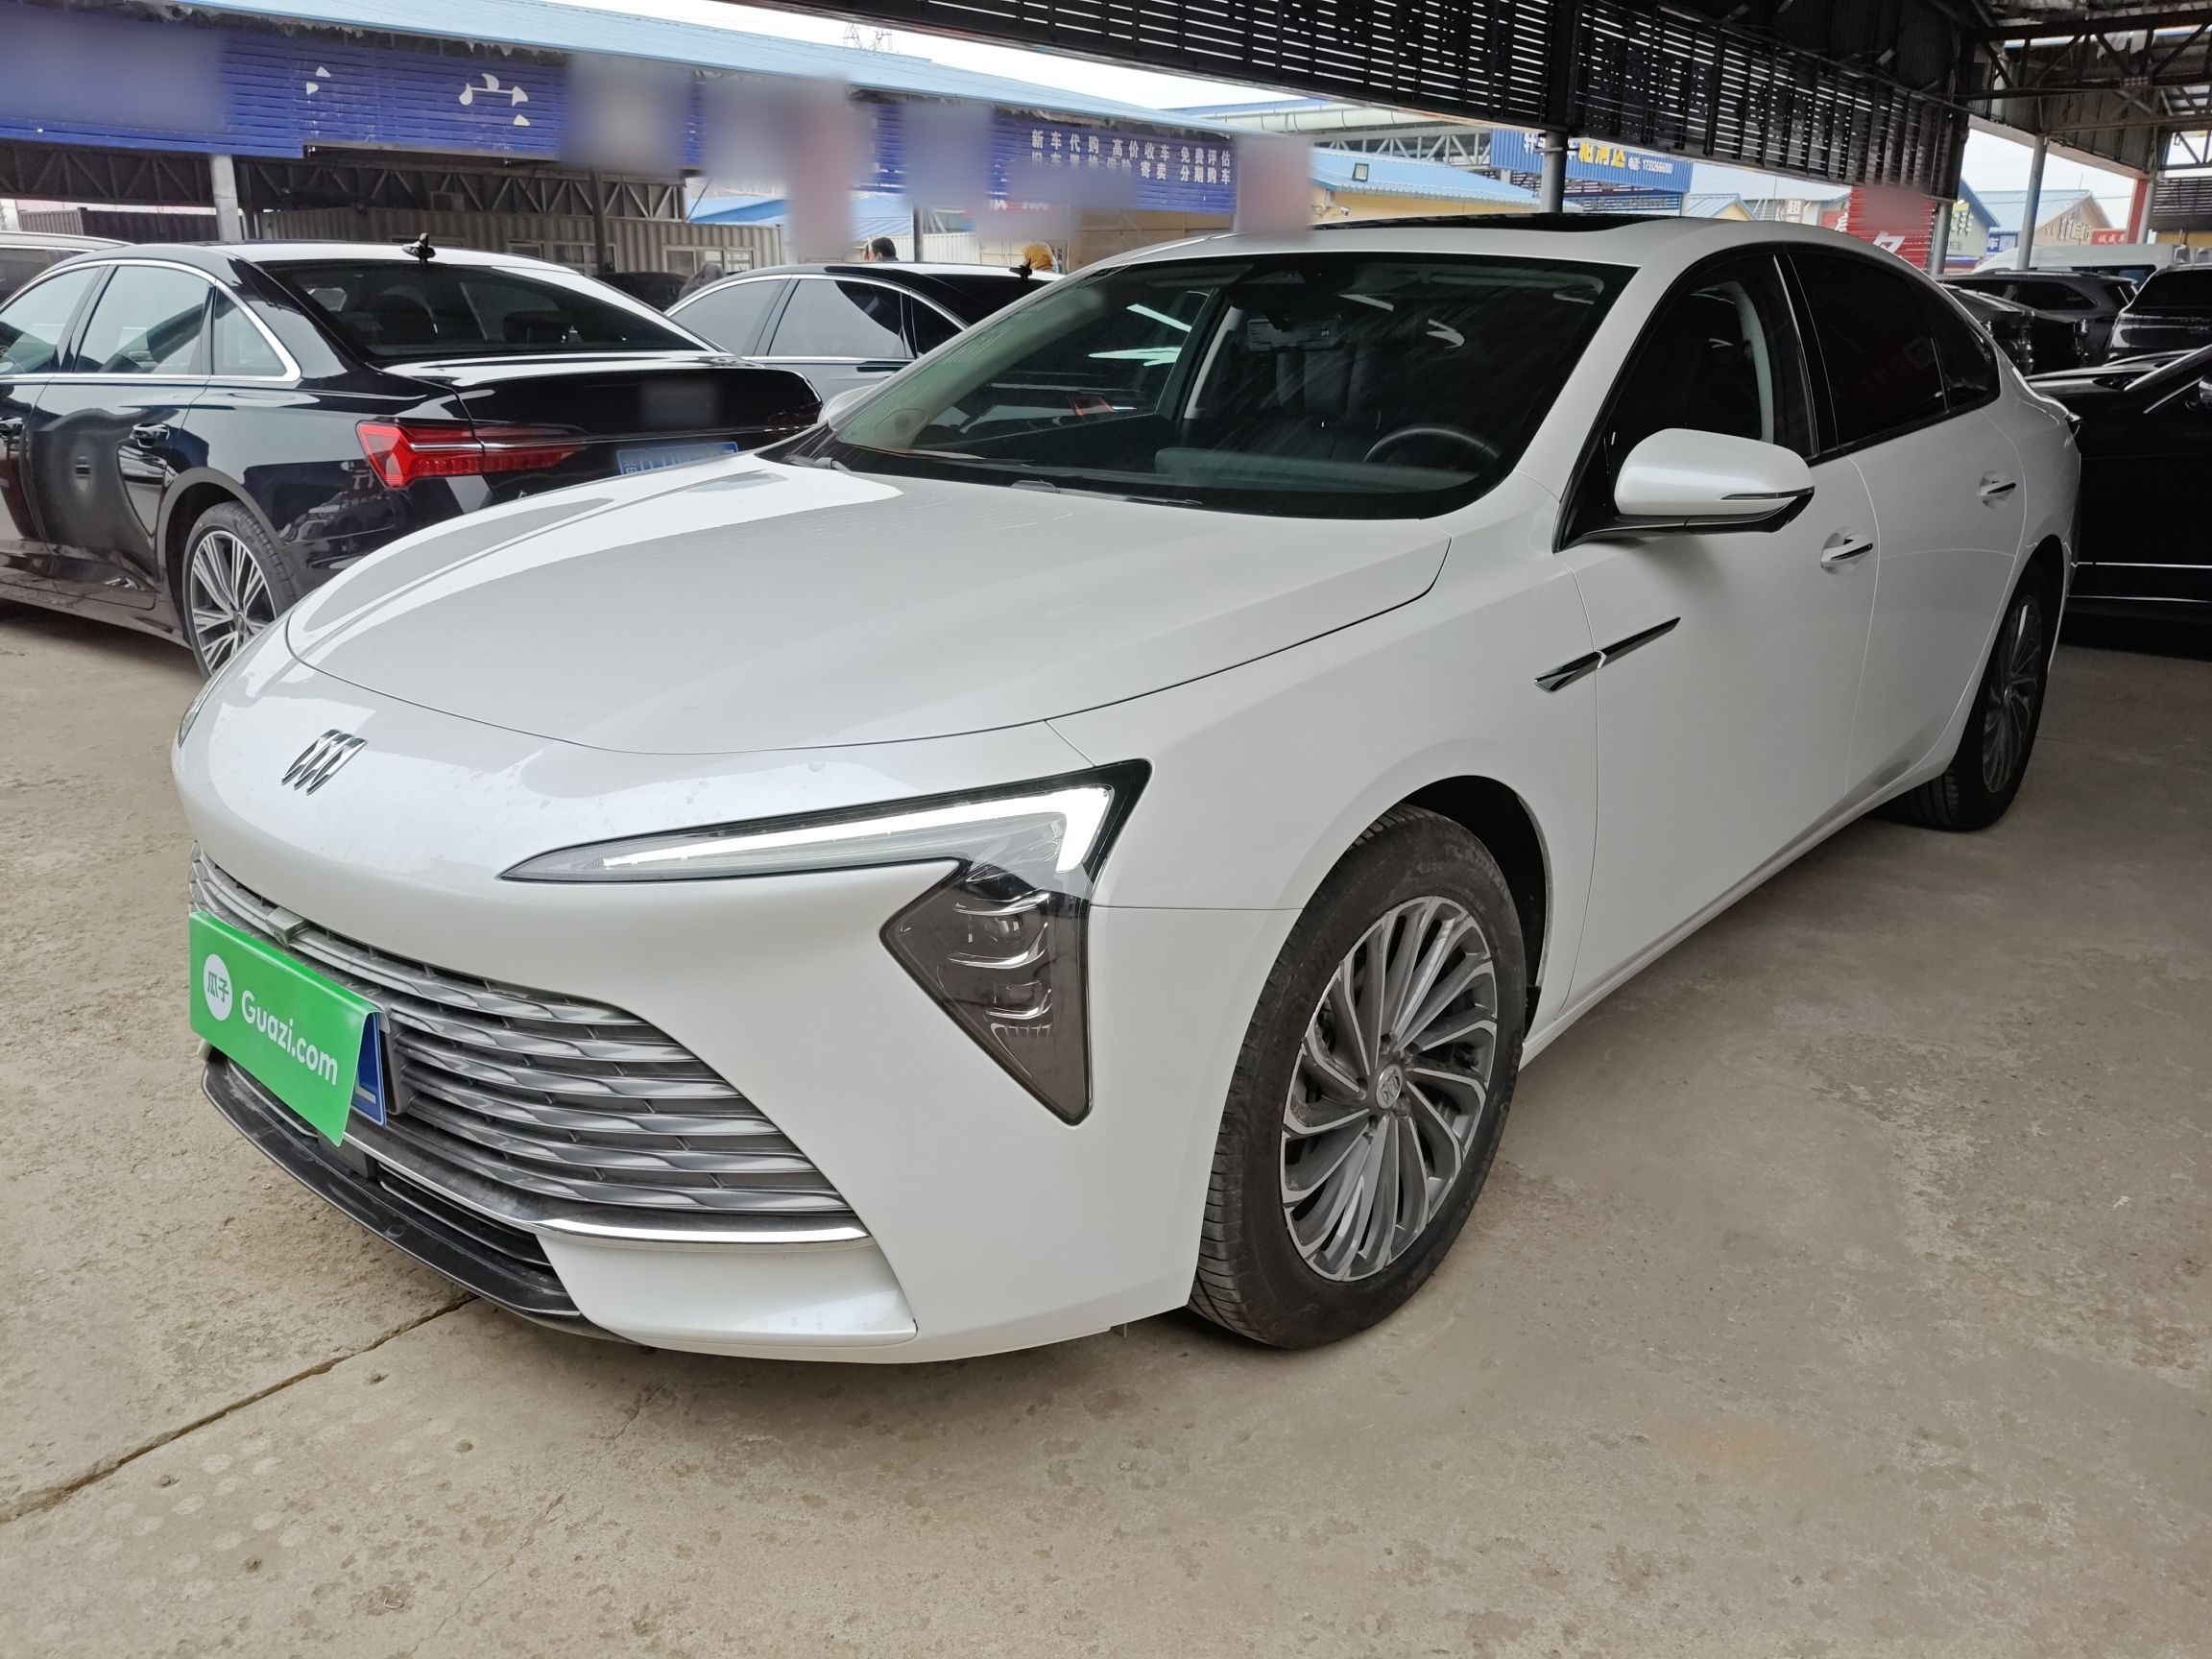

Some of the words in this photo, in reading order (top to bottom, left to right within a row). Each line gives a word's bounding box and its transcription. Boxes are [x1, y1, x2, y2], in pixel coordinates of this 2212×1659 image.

[1032, 130, 1100, 154] 新车代购
[1113, 138, 1170, 161] 高价收车
[1180, 145, 1231, 167] 免费评估
[1140, 160, 1166, 180] 寄卖
[1180, 164, 1231, 185] 分期购车
[206, 971, 229, 1003] 瓜子
[241, 990, 339, 1086] Guazi.com
